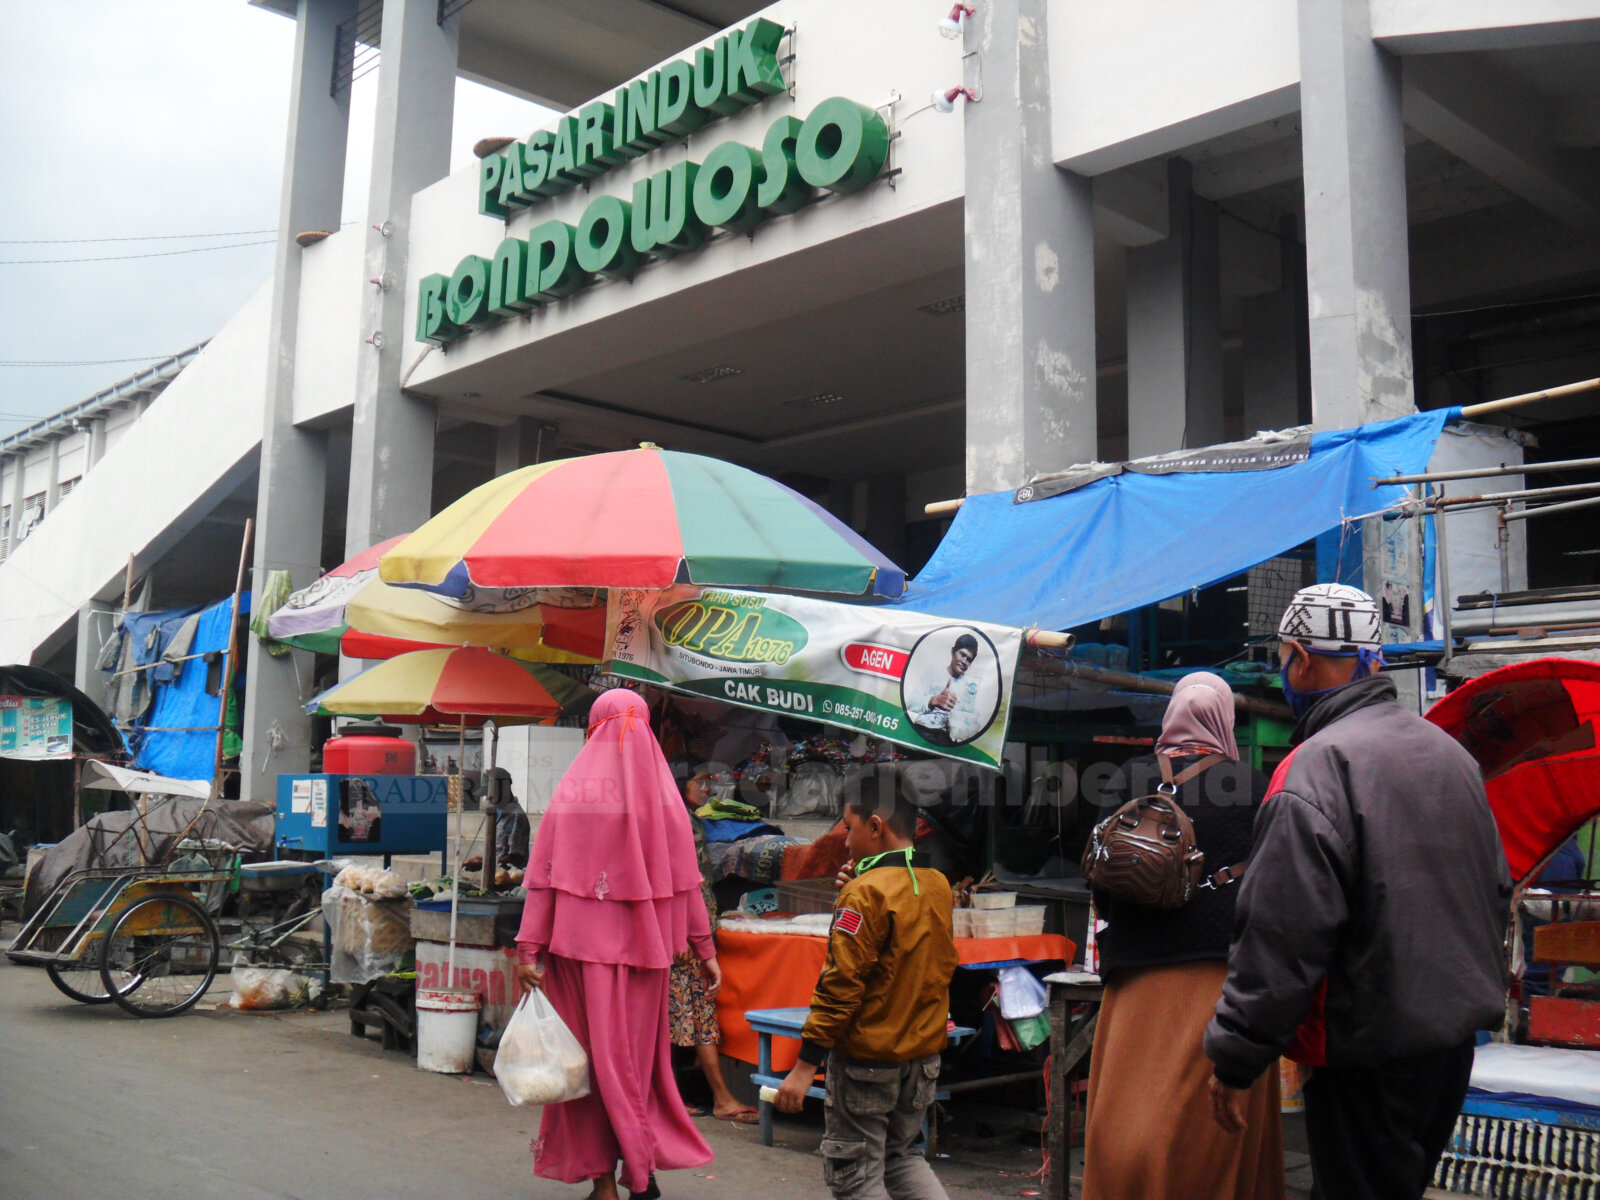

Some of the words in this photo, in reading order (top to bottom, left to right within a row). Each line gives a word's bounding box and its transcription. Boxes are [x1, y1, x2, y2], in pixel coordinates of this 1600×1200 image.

[479, 101, 614, 219] PASAR
[613, 17, 786, 156] INDUK
[415, 96, 889, 345] BONDOWOSO
[702, 590, 730, 605] TAHU
[733, 594, 766, 609] SUSU
[661, 602, 762, 658] OPA
[749, 636, 794, 665] 1976
[678, 651, 715, 671] SITUBONDO
[719, 665, 738, 676] JAWA
[738, 666, 762, 676] TIMUR
[861, 649, 894, 670] AGEN
[724, 679, 762, 703] CAK
[766, 687, 813, 712] BUDI
